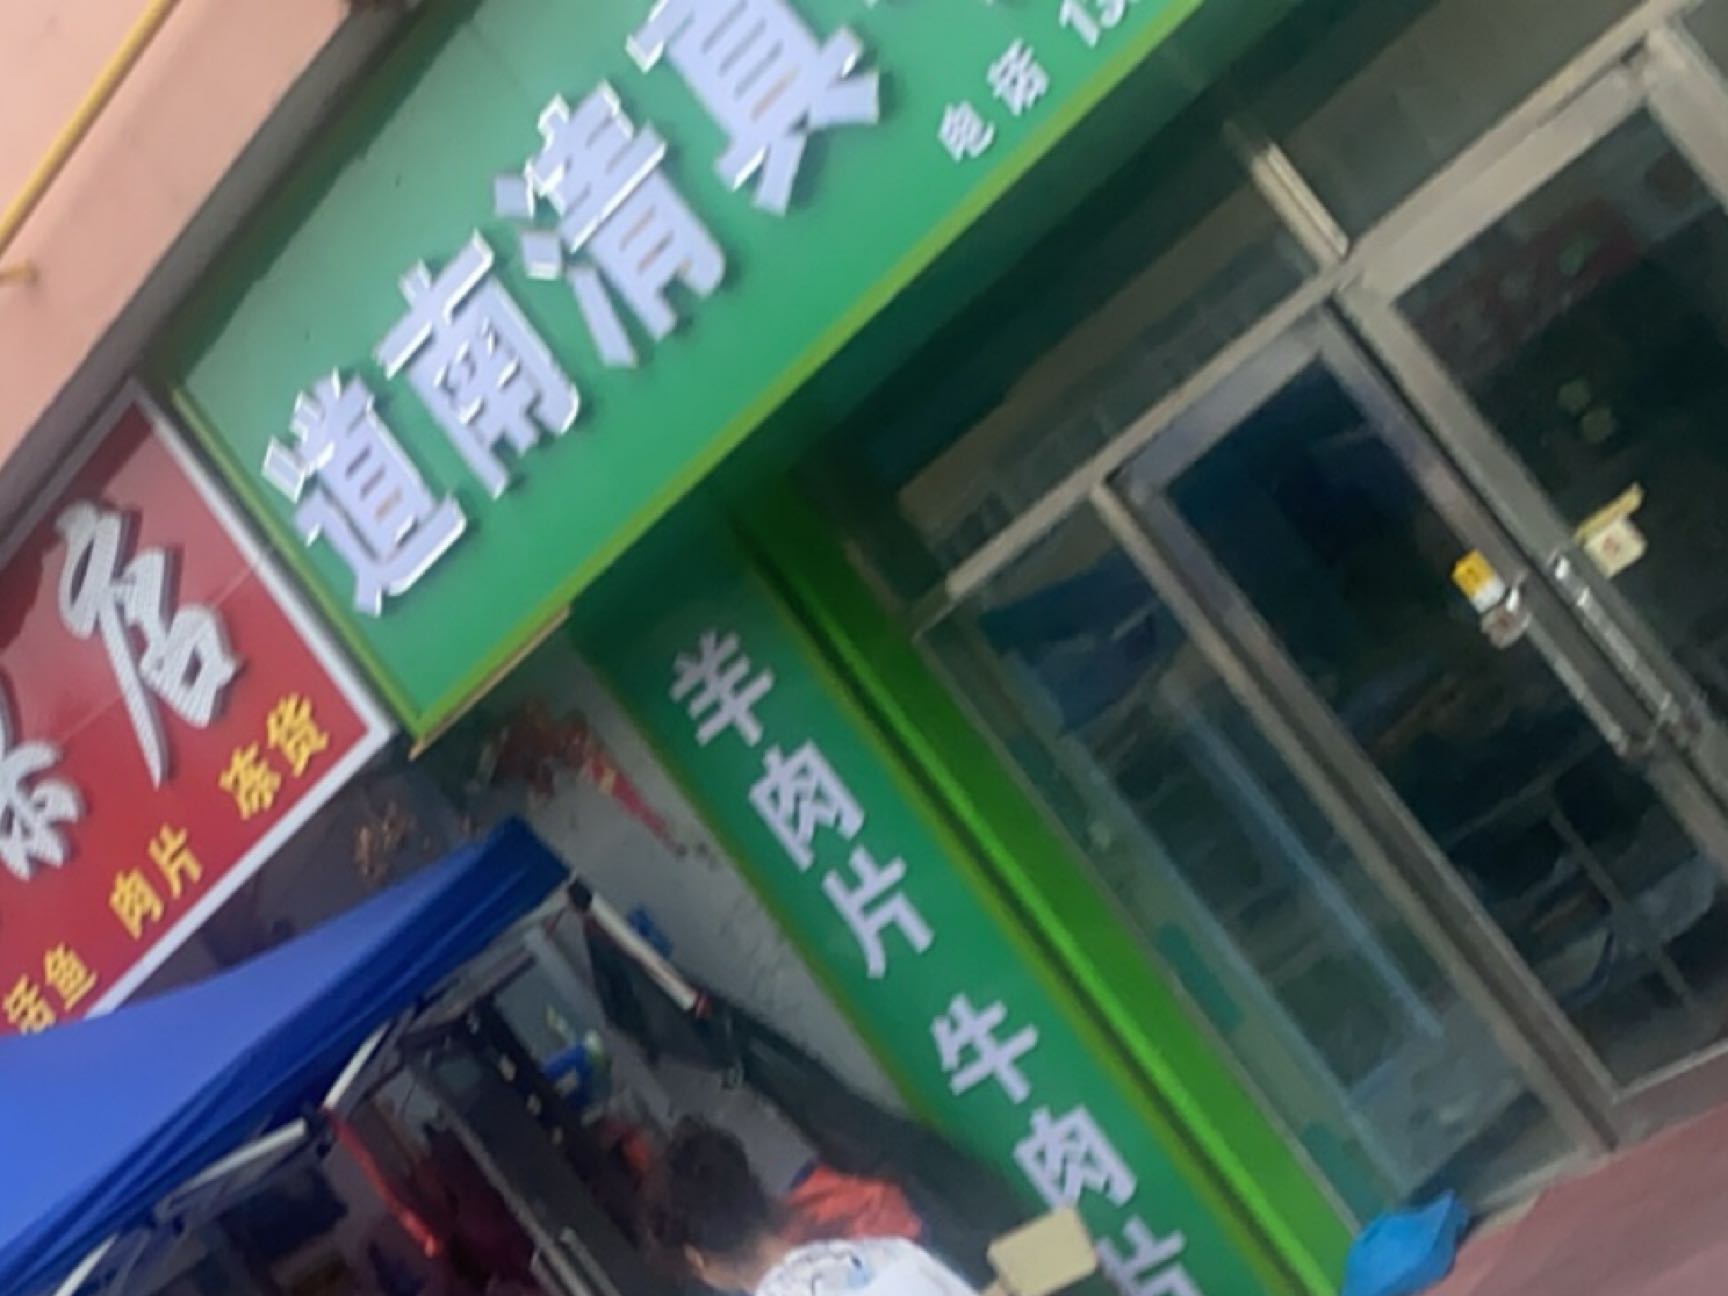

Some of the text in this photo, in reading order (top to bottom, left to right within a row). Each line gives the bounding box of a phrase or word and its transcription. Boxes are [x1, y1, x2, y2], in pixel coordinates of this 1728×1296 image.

[938, 37, 1050, 163] 电话
[262, 0, 879, 616] 道南清真
[1, 693, 333, 1036] 活鱼 肉片 冻货
[670, 628, 935, 979] 羊肉片
